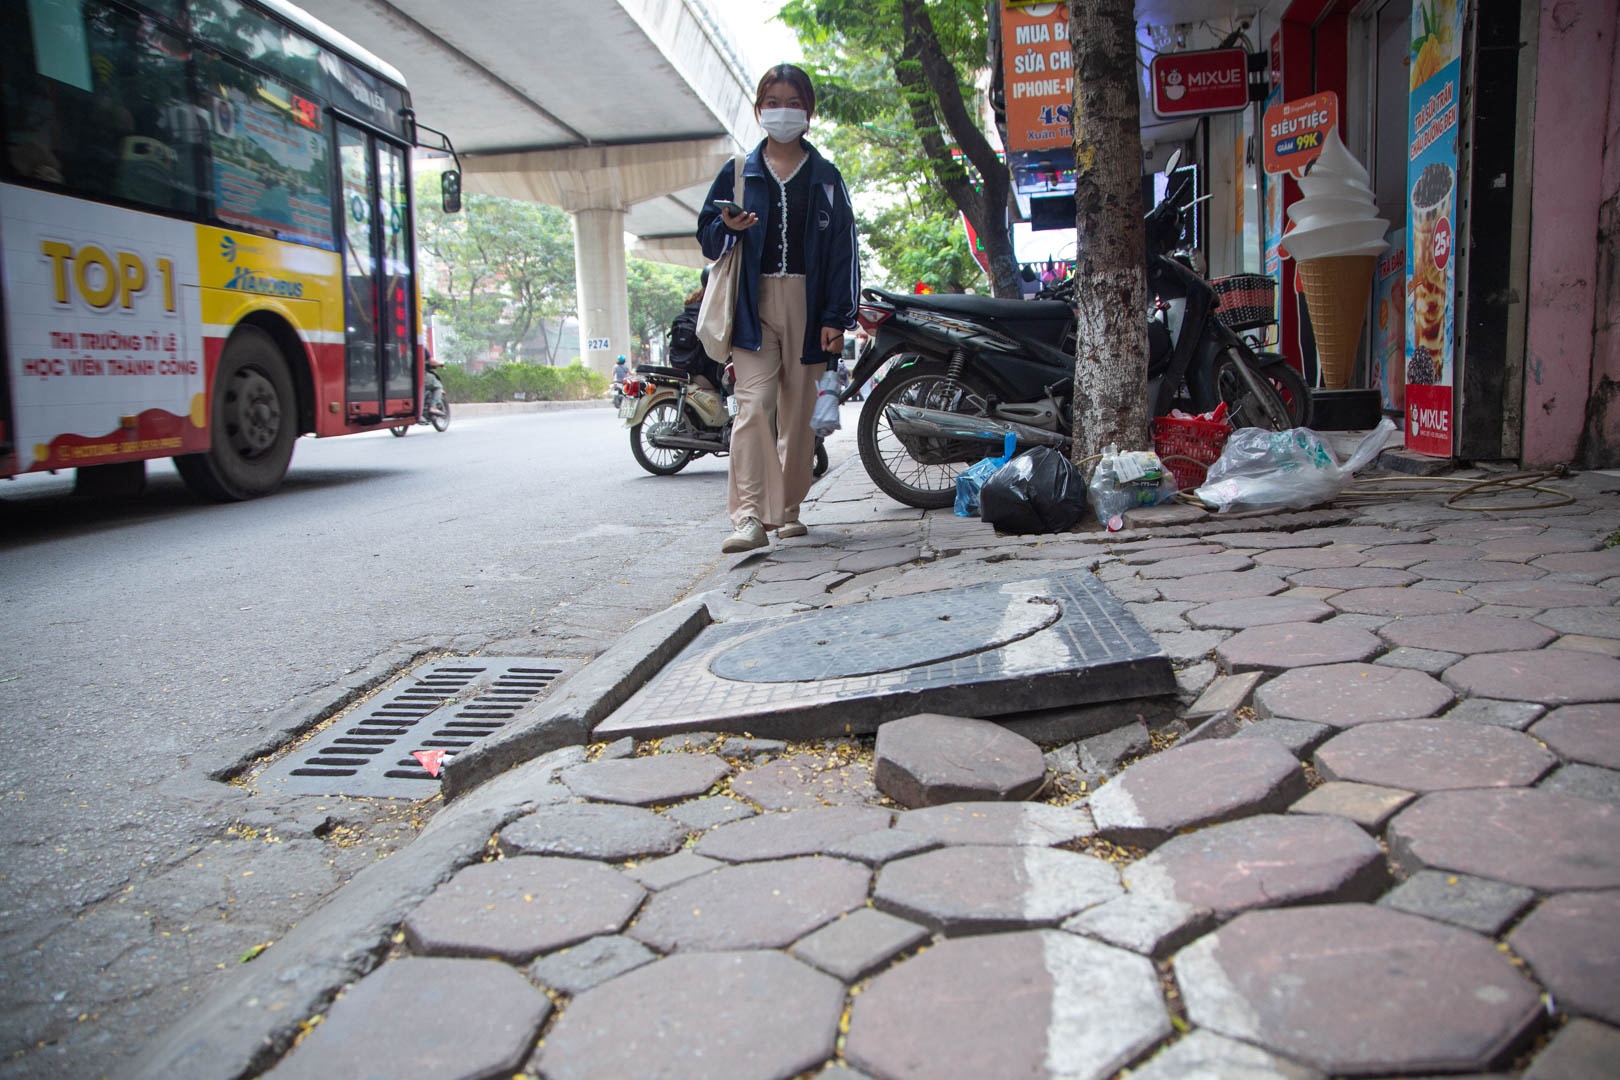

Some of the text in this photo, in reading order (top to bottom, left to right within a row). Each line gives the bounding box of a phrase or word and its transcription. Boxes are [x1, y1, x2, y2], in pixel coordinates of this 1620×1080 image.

[1016, 24, 1050, 45] MUA
[1014, 48, 1046, 74] SỬA
[1187, 69, 1241, 87] MIXUE
[1026, 129, 1056, 142] Xuân
[1271, 110, 1329, 138] SIÊU TIỆC
[1296, 132, 1318, 150] 99K
[41, 240, 176, 312] TOP 1
[22, 358, 65, 382] HỌC
[1419, 409, 1449, 432] MIXUE
